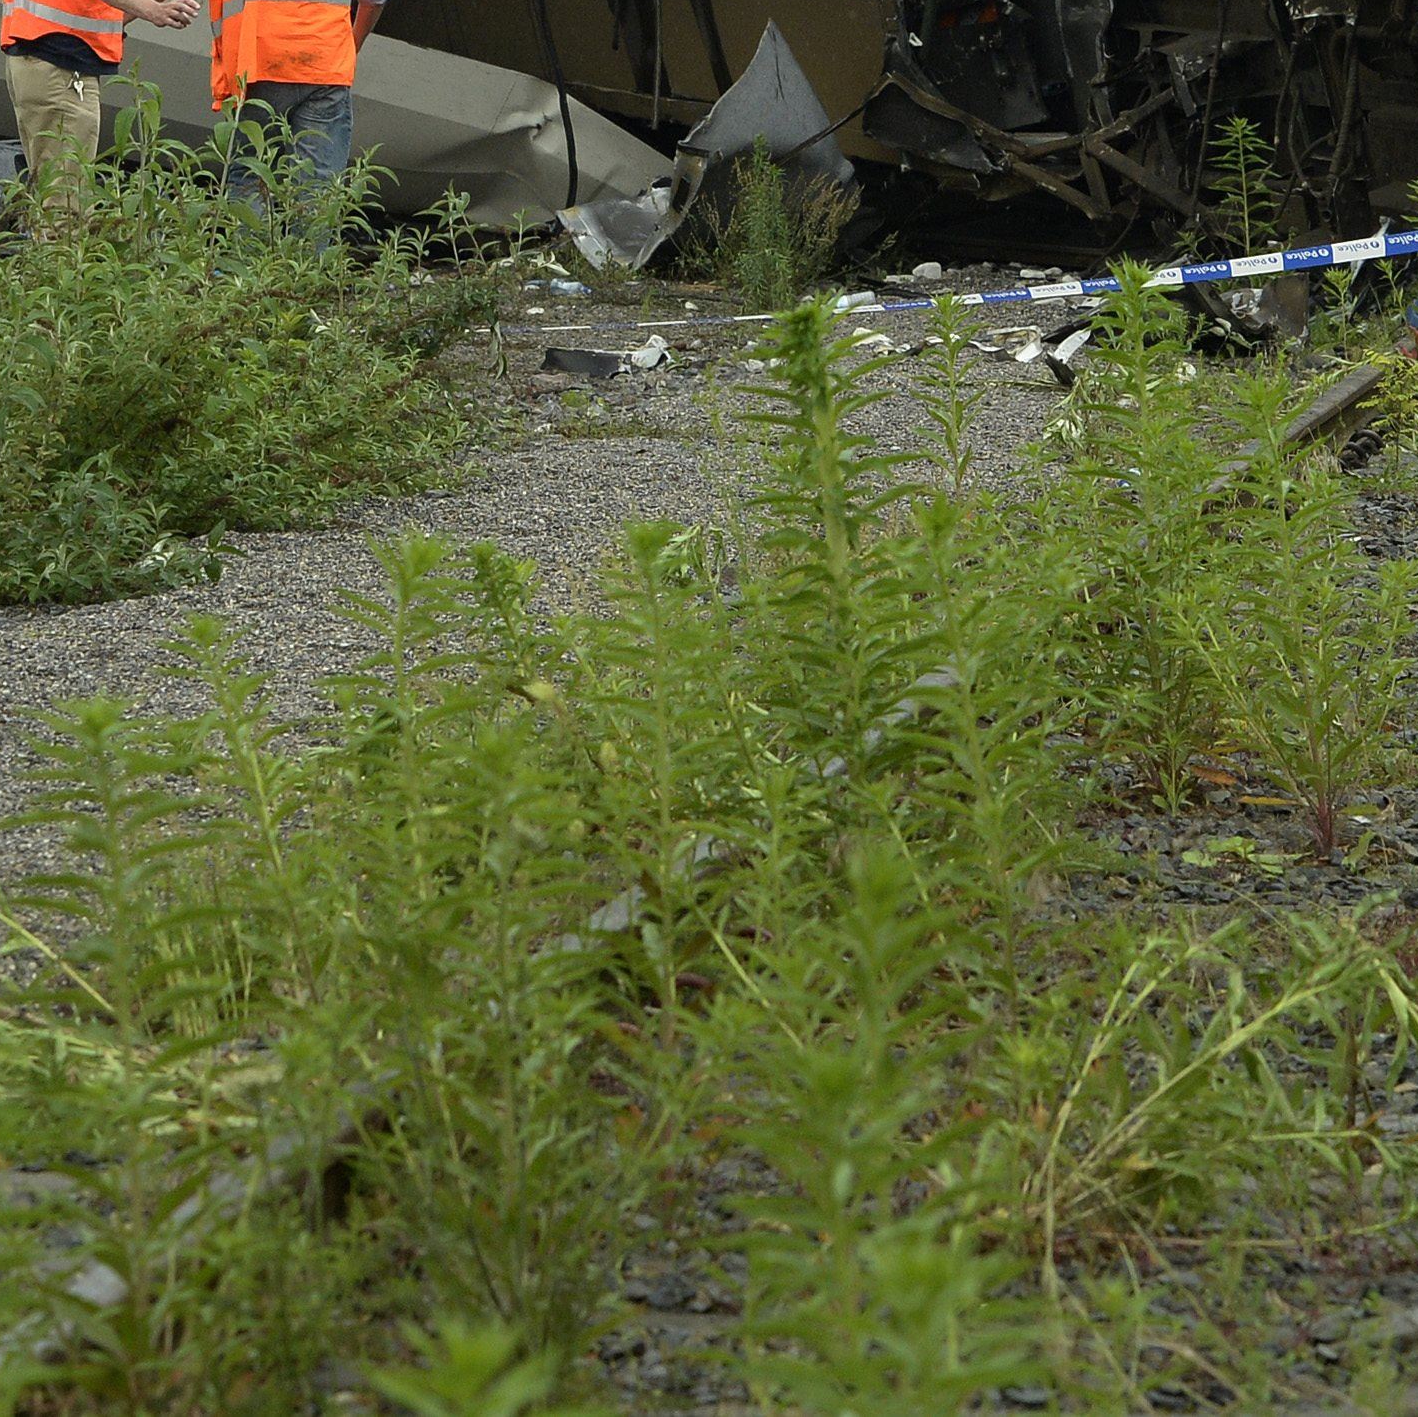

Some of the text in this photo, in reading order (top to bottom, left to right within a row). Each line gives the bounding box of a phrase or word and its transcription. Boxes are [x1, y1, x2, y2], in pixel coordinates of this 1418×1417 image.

[1184, 266, 1216, 275] Police
[1237, 259, 1267, 269] Police
[1286, 251, 1318, 261] Police
[1337, 243, 1369, 253] Police
